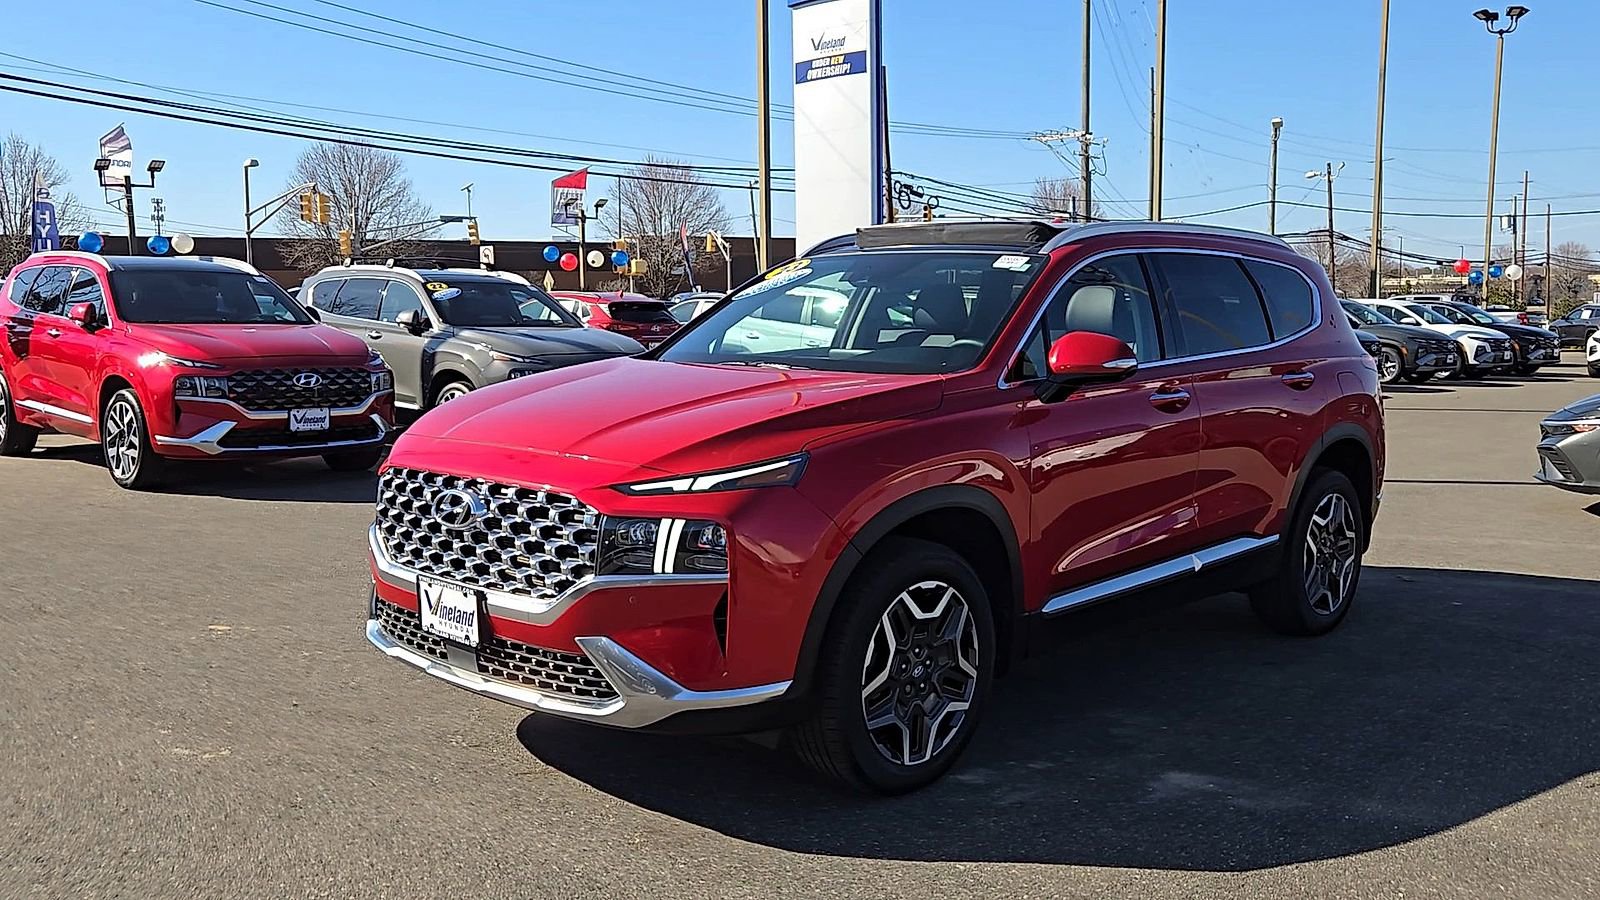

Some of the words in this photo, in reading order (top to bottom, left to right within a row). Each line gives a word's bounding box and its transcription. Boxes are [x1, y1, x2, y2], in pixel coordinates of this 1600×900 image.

[811, 32, 846, 51] Vineland
[807, 63, 850, 80] OWNERSHIP!
[293, 410, 326, 424] Vineland
[424, 587, 475, 627] Vineland
[438, 620, 474, 635] HYUNDAI
